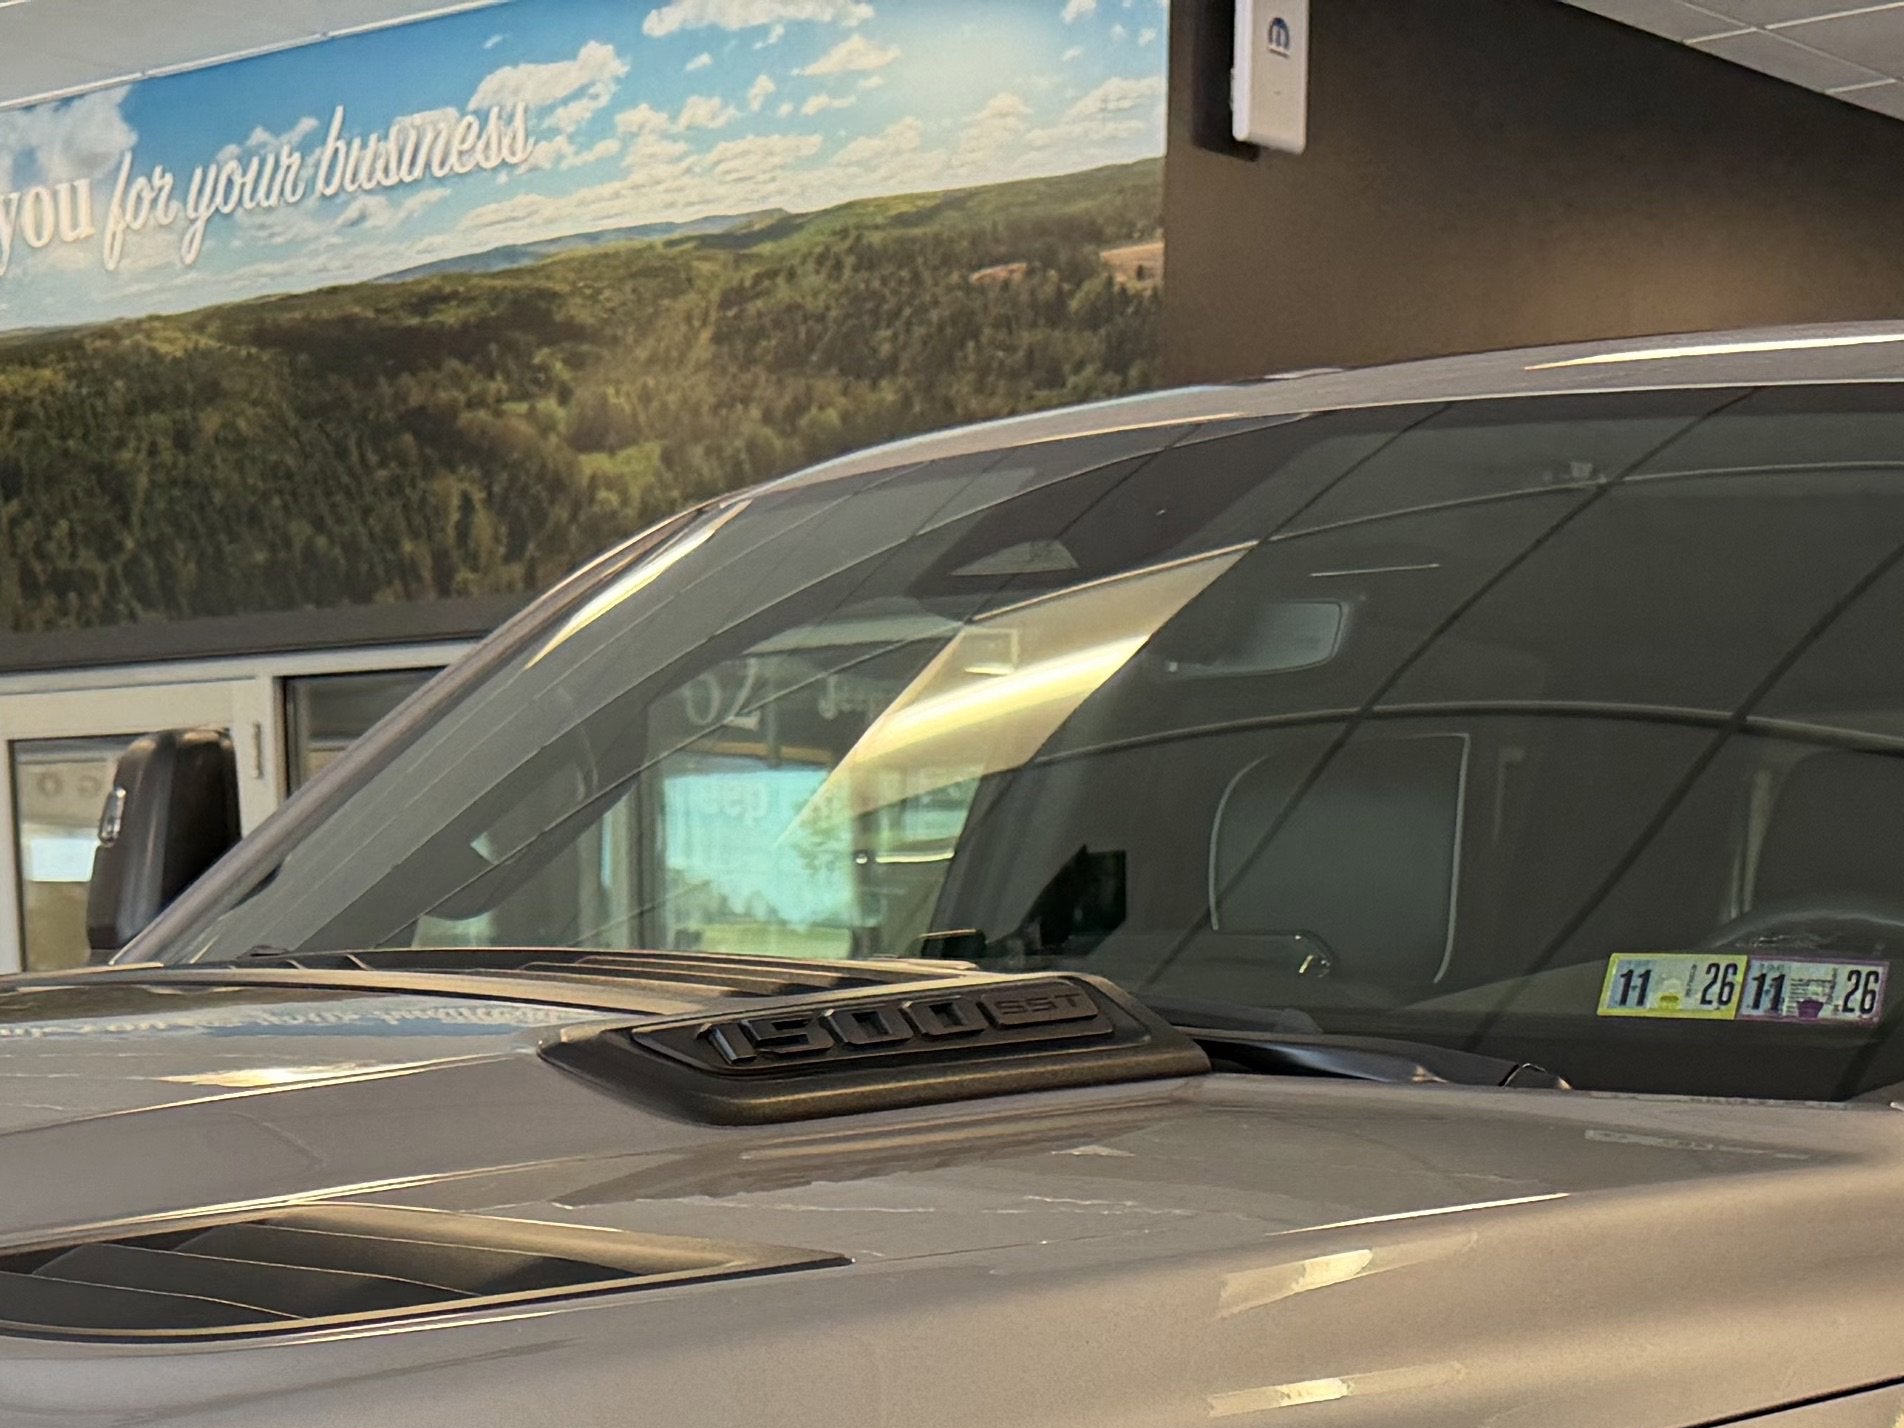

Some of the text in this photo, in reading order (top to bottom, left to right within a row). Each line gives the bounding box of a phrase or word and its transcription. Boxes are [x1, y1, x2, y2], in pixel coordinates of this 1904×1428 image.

[100, 149, 180, 271] for
[187, 142, 305, 266] your
[315, 101, 539, 199] business
[1618, 968, 1653, 1007] 11
[1699, 962, 1739, 1006] 26
[1751, 972, 1786, 1012] 11
[1841, 969, 1880, 1015] 26
[698, 992, 1082, 1065] 1500 SST
